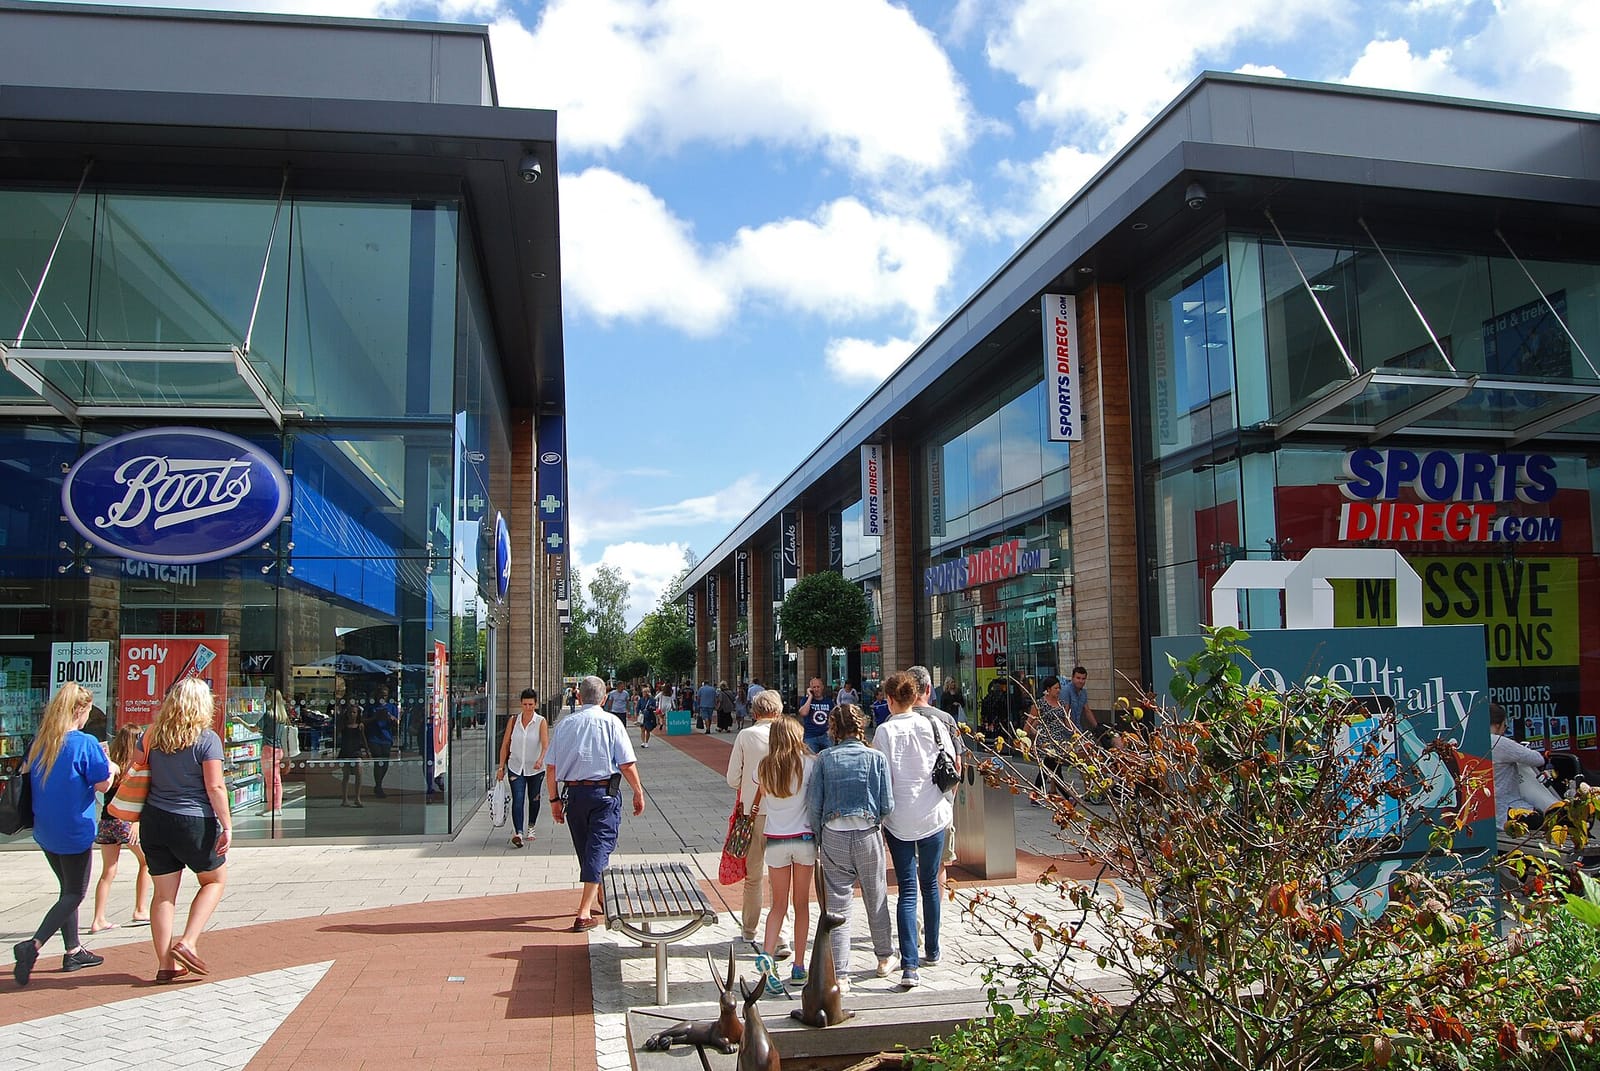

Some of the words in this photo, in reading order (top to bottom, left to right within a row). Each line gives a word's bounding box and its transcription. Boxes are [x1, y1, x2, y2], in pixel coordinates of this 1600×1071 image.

[95, 455, 252, 530] Boots
[1339, 449, 1558, 503] SPORTS
[1338, 502, 1563, 542] DIRECT.COM
[784, 524, 797, 566] Clarks
[1356, 561, 1553, 619] MSSIVE
[56, 660, 103, 683] BOOM!
[127, 643, 169, 664] only
[127, 664, 156, 696] £1
[1526, 703, 1558, 720] DAILY
[1552, 739, 1569, 749] SALE
